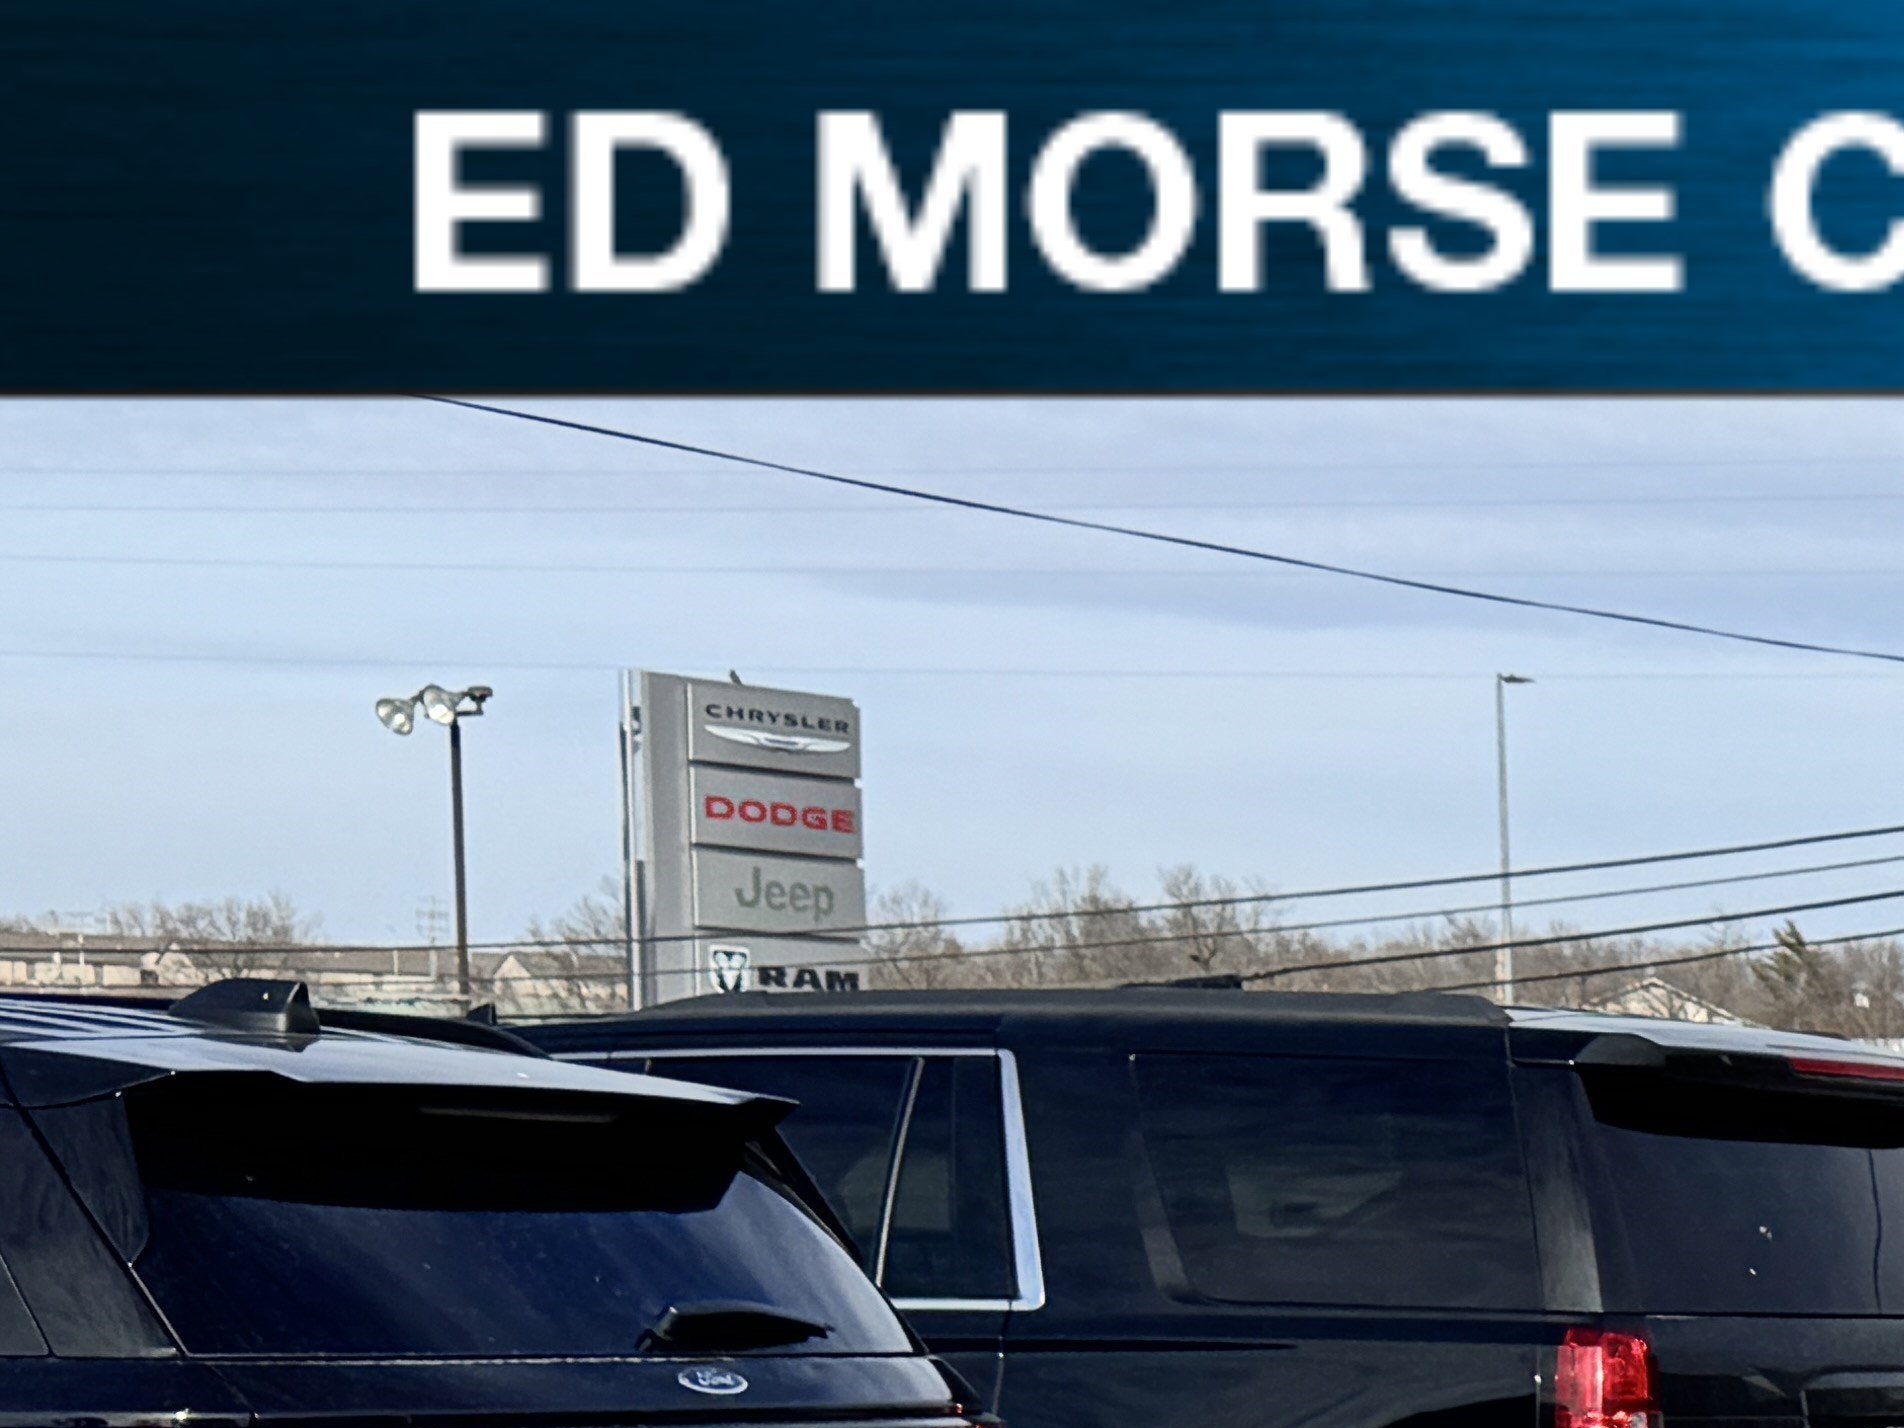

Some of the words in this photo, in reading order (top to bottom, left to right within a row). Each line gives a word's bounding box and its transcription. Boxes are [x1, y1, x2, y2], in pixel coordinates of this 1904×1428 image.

[705, 703, 850, 734] CHRYSLER
[704, 795, 855, 834] DODGE
[734, 865, 835, 922] Jeep
[757, 965, 860, 991] RAM
